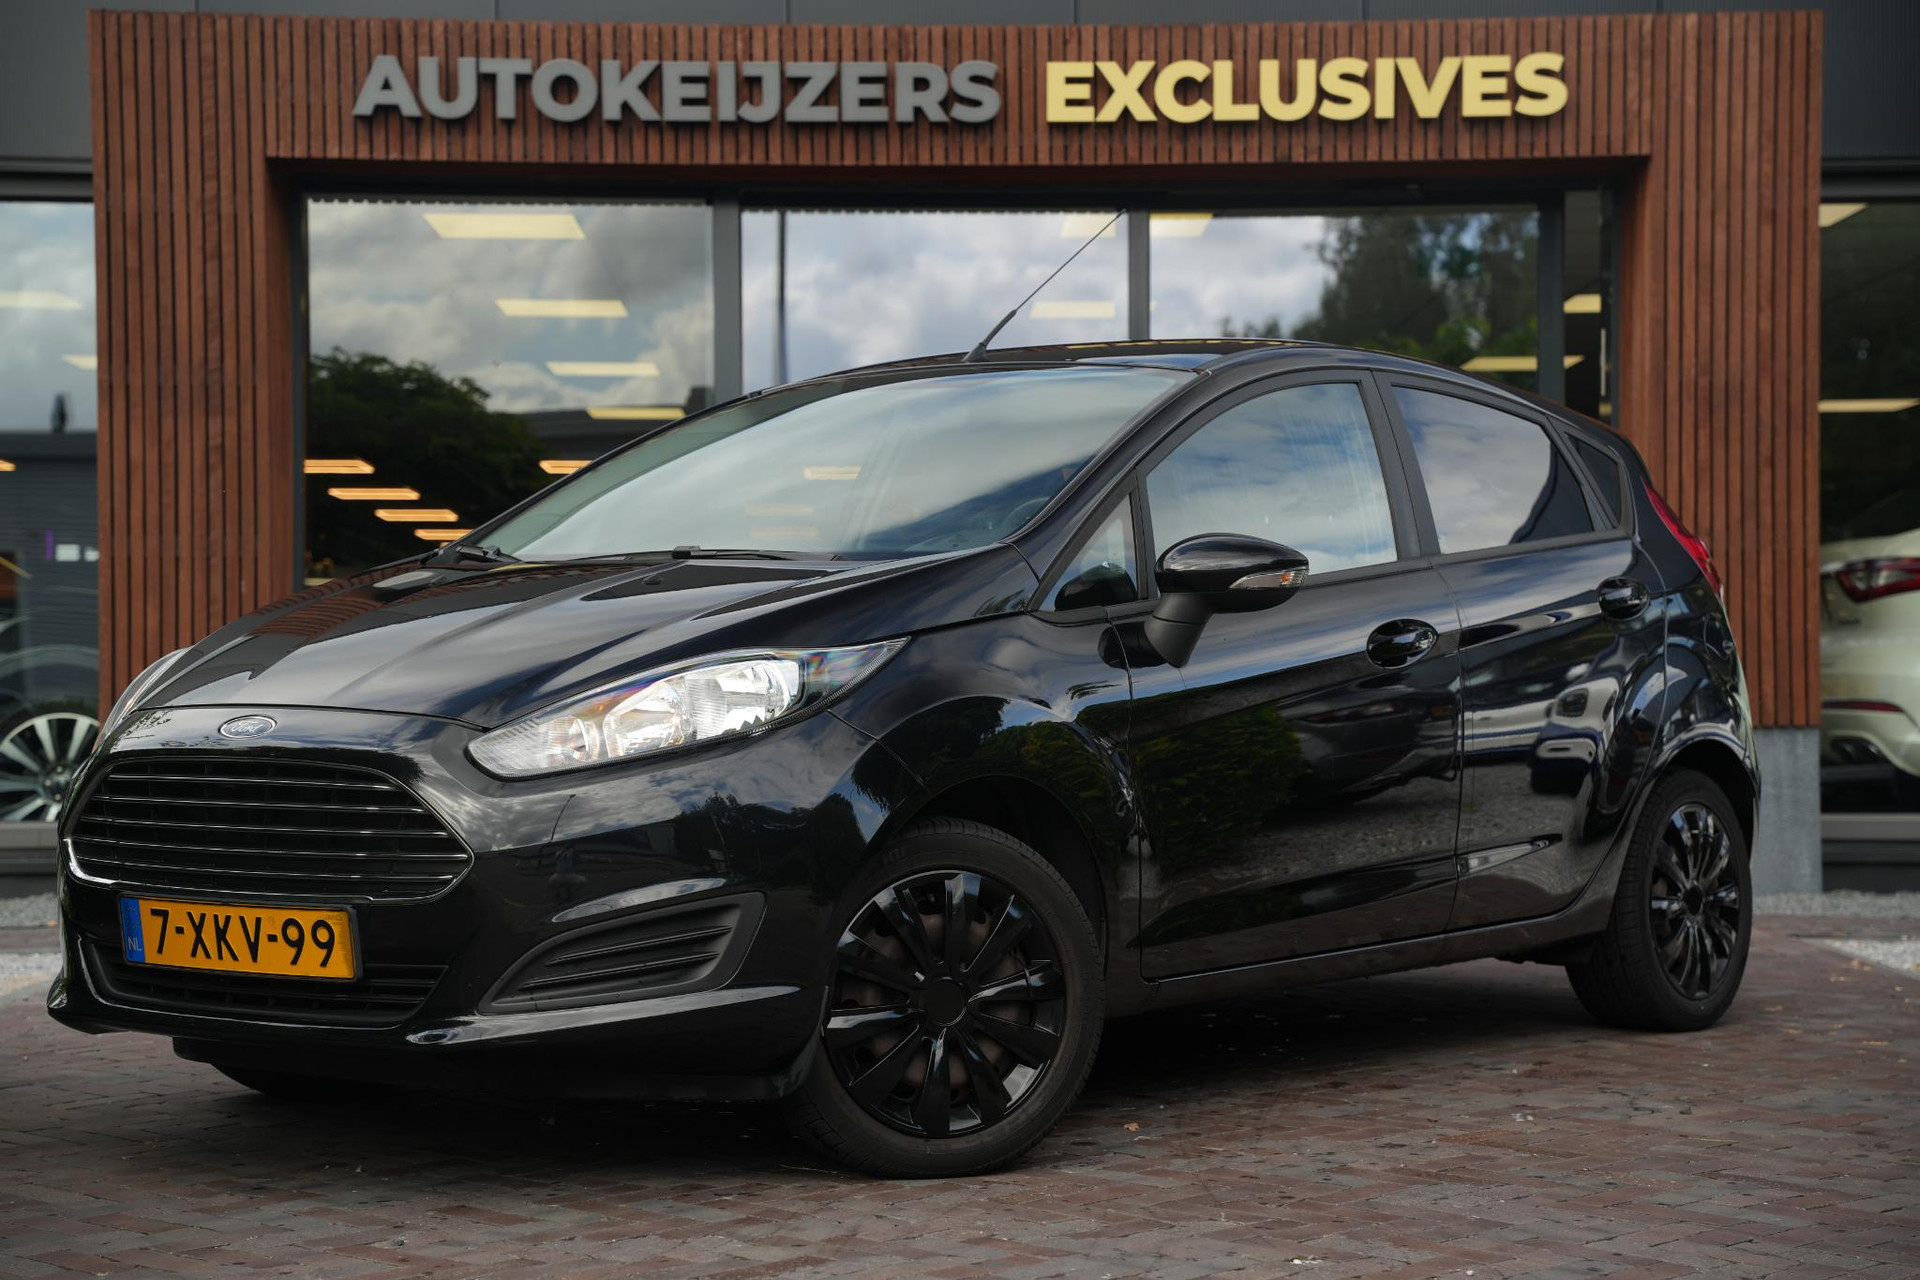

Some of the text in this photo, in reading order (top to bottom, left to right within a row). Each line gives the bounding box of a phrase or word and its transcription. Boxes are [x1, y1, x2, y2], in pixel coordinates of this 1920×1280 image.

[352, 51, 1569, 123] AUTOKEIJZERS EXCLUSIVES
[128, 936, 143, 951] NL
[150, 908, 336, 968] 7-XKV-99
